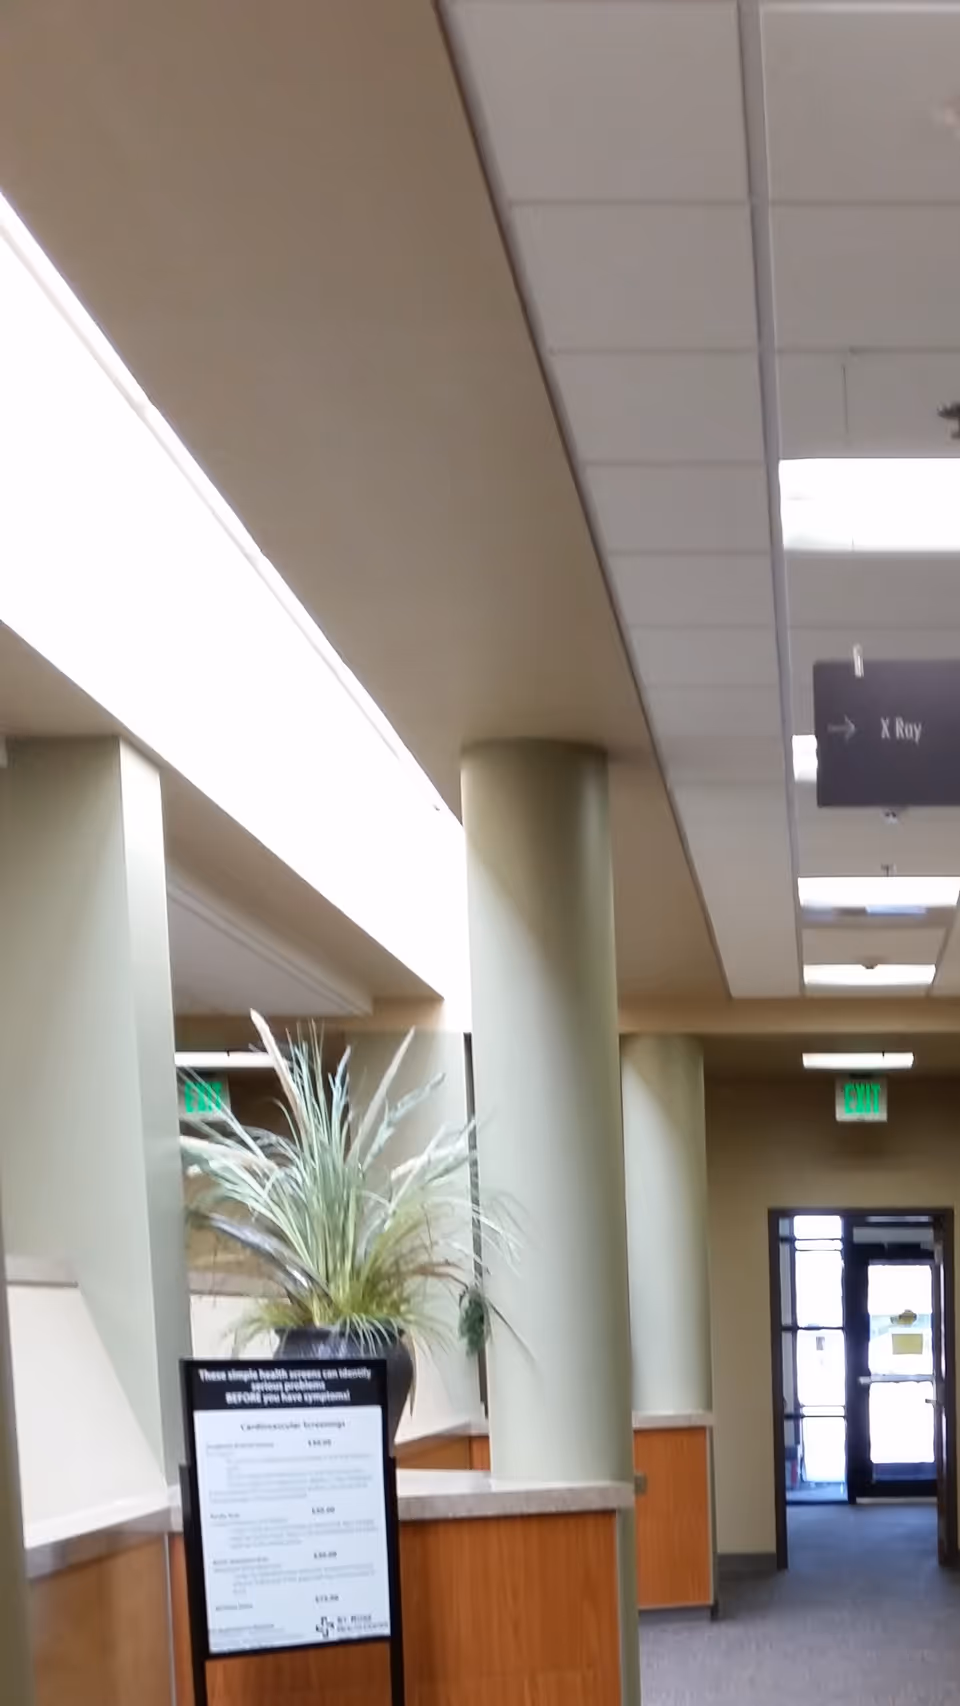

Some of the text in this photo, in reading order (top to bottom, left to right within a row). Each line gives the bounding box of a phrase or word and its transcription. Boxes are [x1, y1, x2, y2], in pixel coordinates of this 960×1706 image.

[880, 716, 922, 743] X Ray
[844, 1082, 880, 1114] EXIT
[198, 1368, 226, 1381] These
[227, 1368, 258, 1382] simple
[258, 1367, 288, 1380] health
[289, 1369, 321, 1380] screens
[322, 1368, 338, 1380] can
[251, 1379, 326, 1392] serious problems
[225, 1388, 351, 1405] BEFORE you have symptoms!
